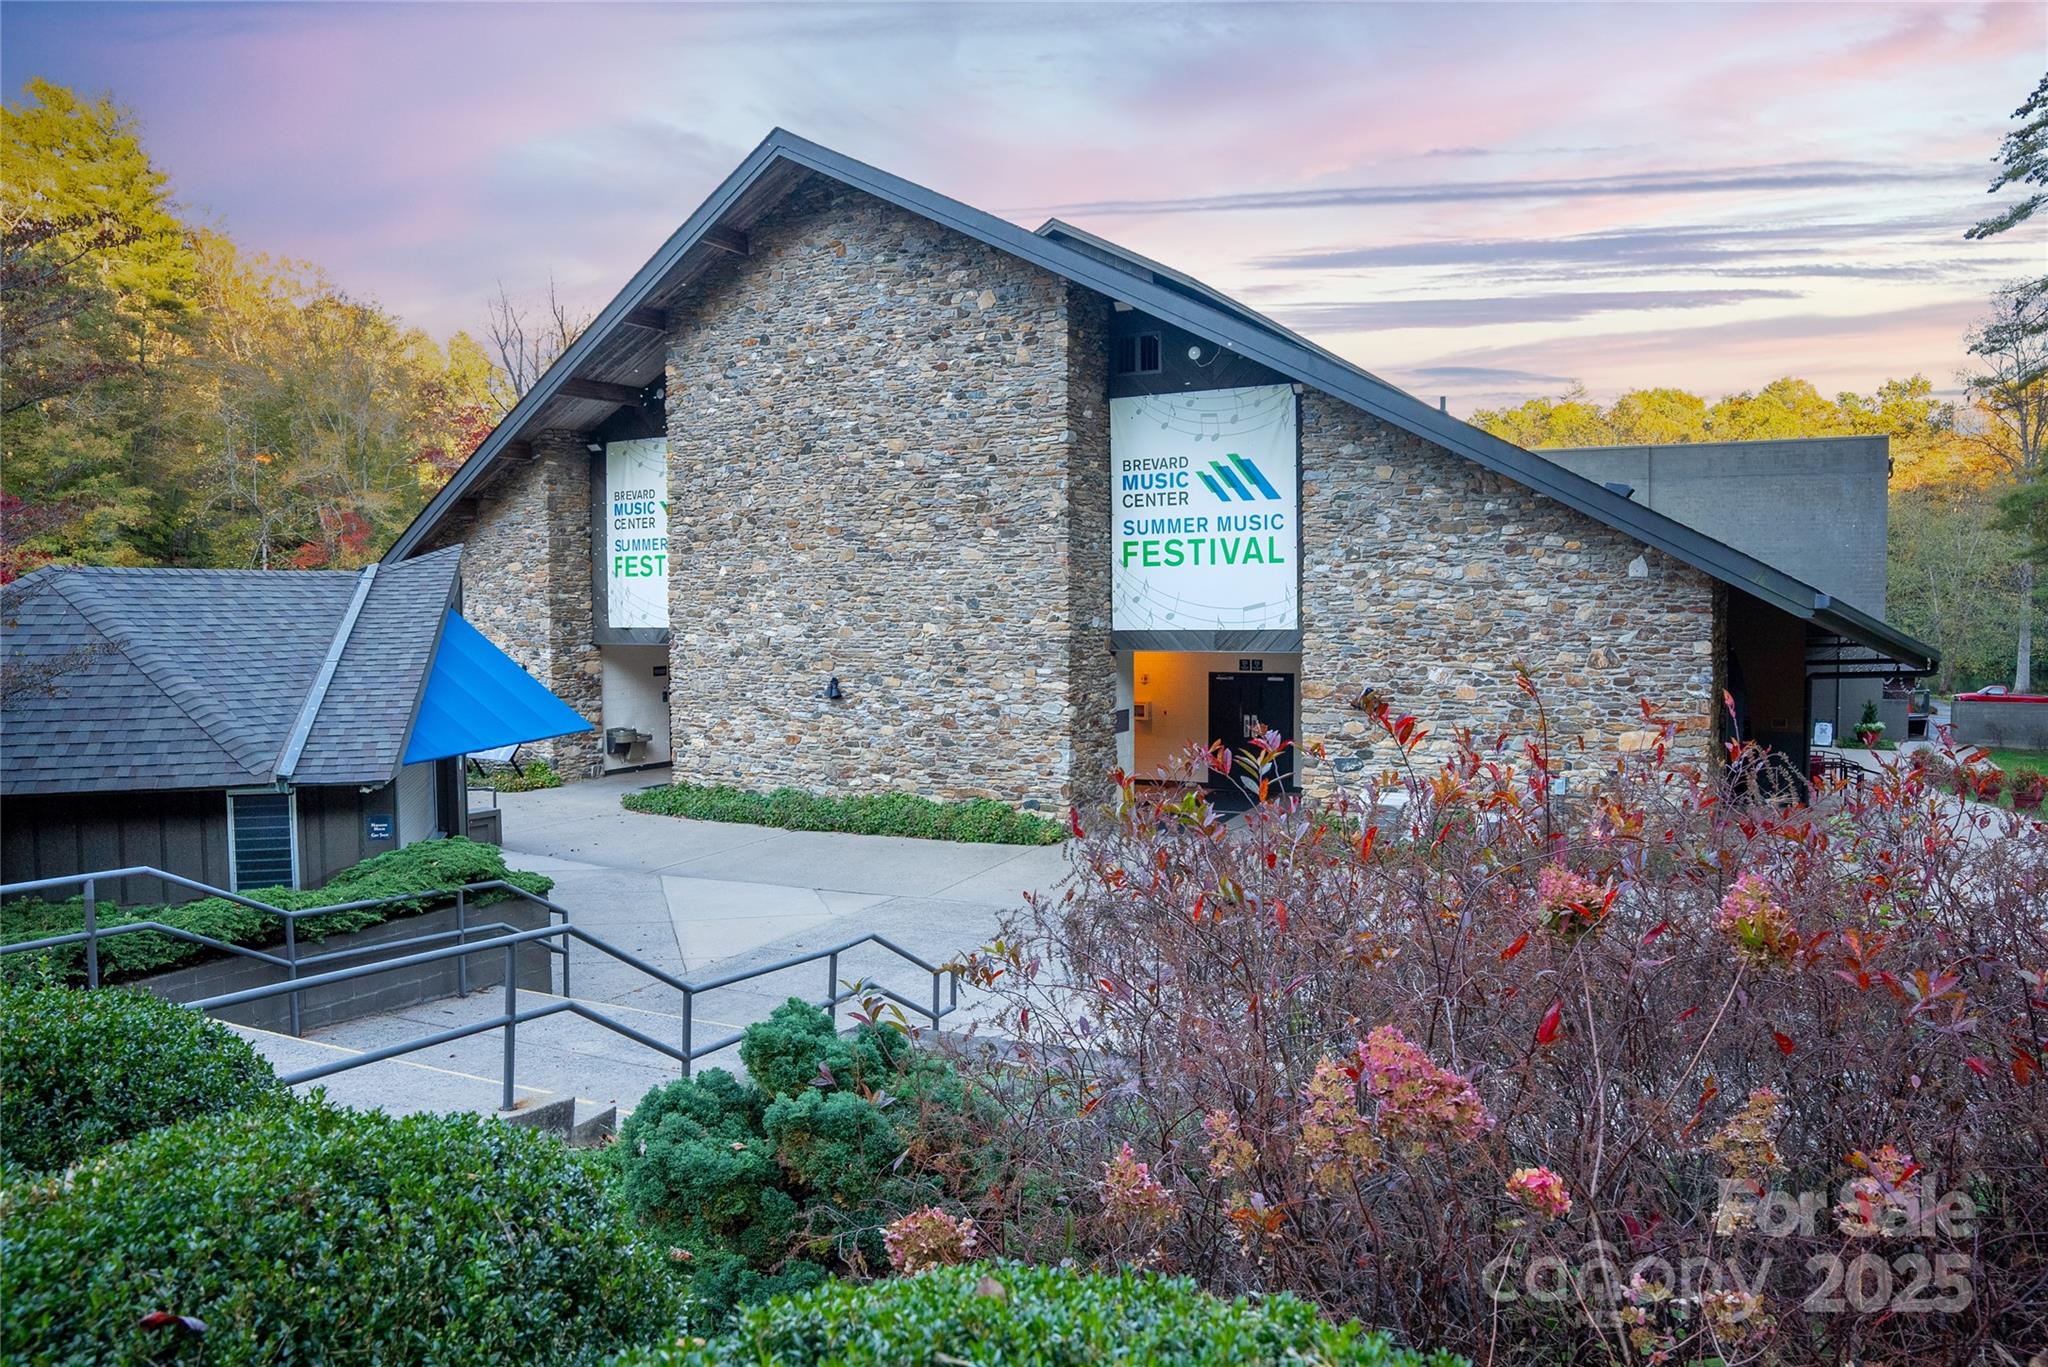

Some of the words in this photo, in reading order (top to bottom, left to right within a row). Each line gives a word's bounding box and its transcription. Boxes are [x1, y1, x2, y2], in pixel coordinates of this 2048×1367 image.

[1122, 456, 1189, 472] BREVARD
[1122, 471, 1190, 491] MUSIC
[614, 488, 656, 501] BREVARD
[1122, 491, 1189, 508] CENTER
[614, 501, 656, 517] MUSIC
[614, 517, 656, 530] CENTER
[1123, 517, 1208, 536] SUMMER
[1217, 513, 1284, 532] MUSIC
[614, 537, 668, 552] SUMMER
[1122, 535, 1285, 568] FESTIVAL
